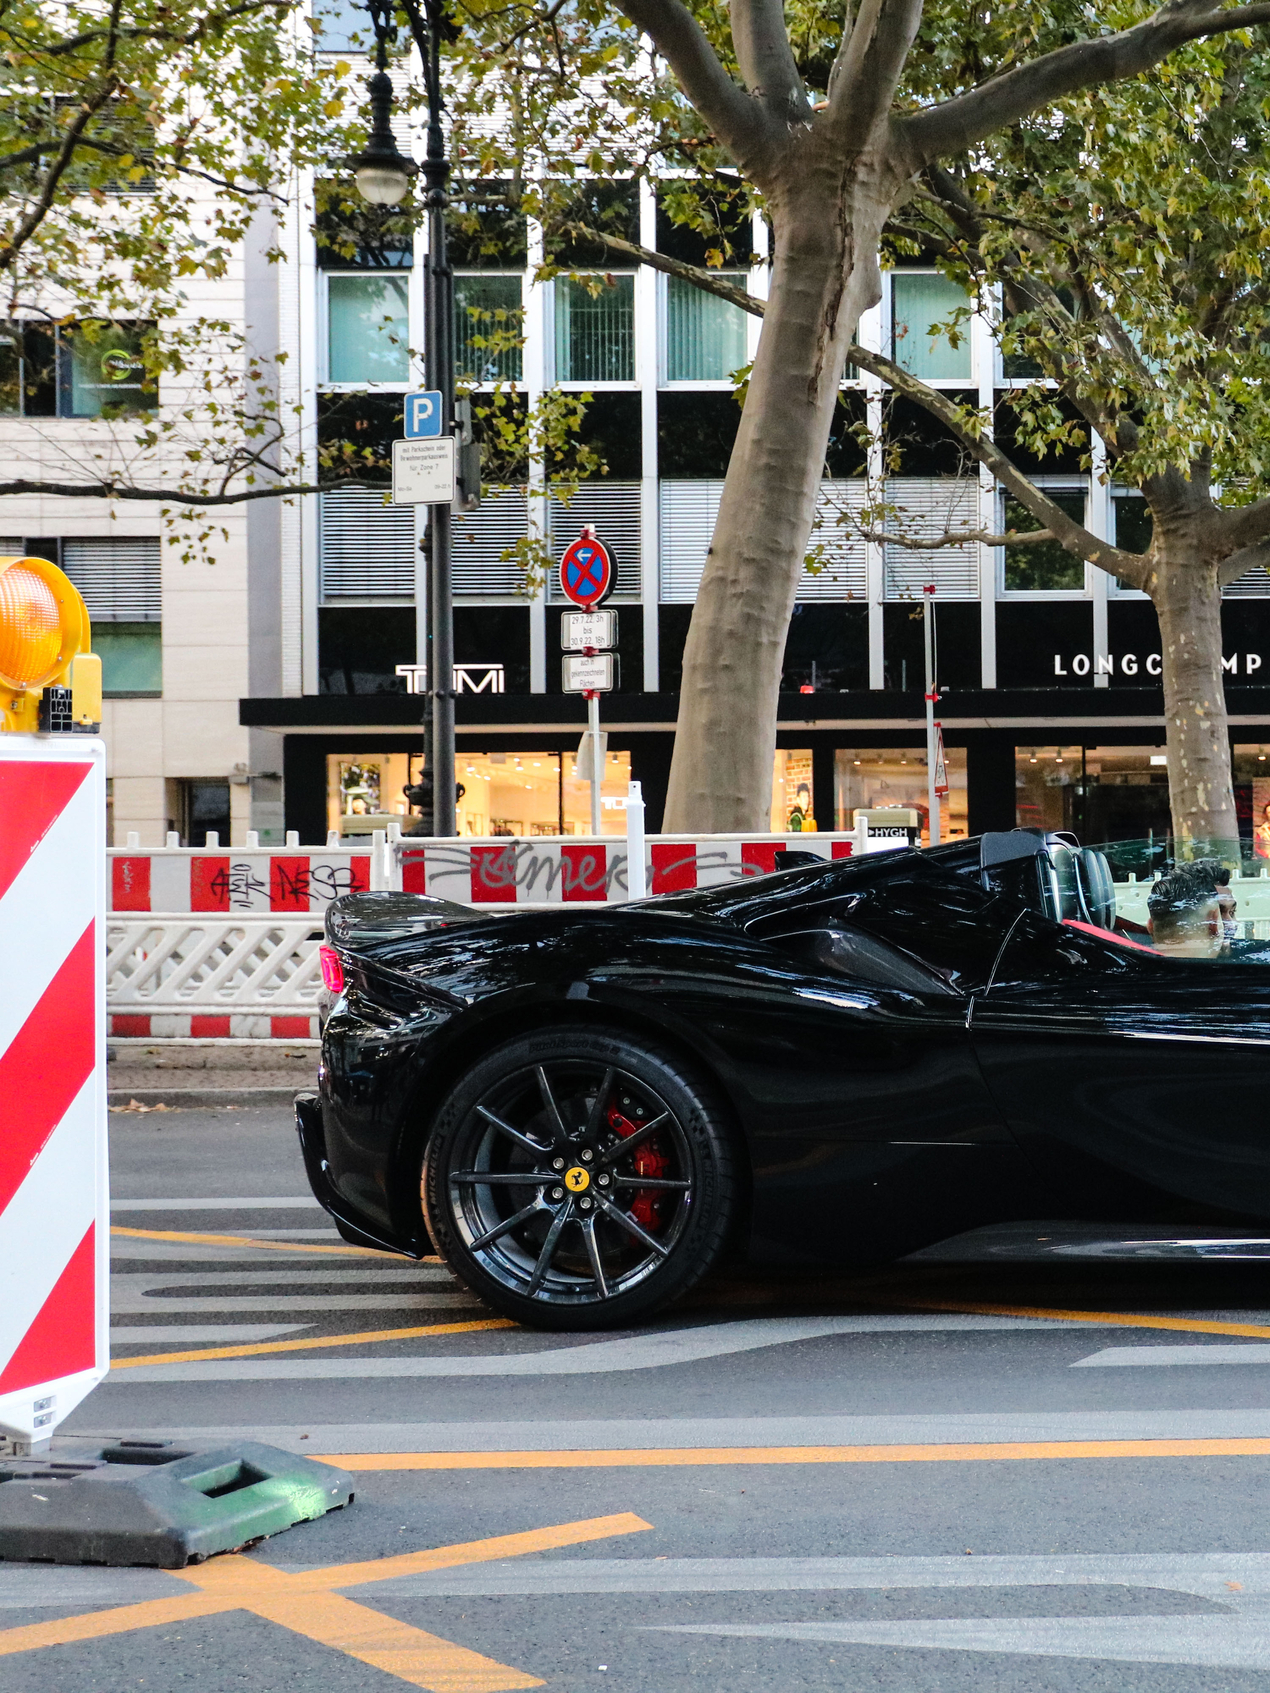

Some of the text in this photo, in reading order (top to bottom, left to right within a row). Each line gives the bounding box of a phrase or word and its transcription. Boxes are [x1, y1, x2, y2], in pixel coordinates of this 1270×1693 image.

[413, 398, 433, 432] P
[1054, 653, 1262, 675] LONGCMP
[875, 828, 907, 837] HYGH
[429, 1133, 443, 1204] MICHELIN
